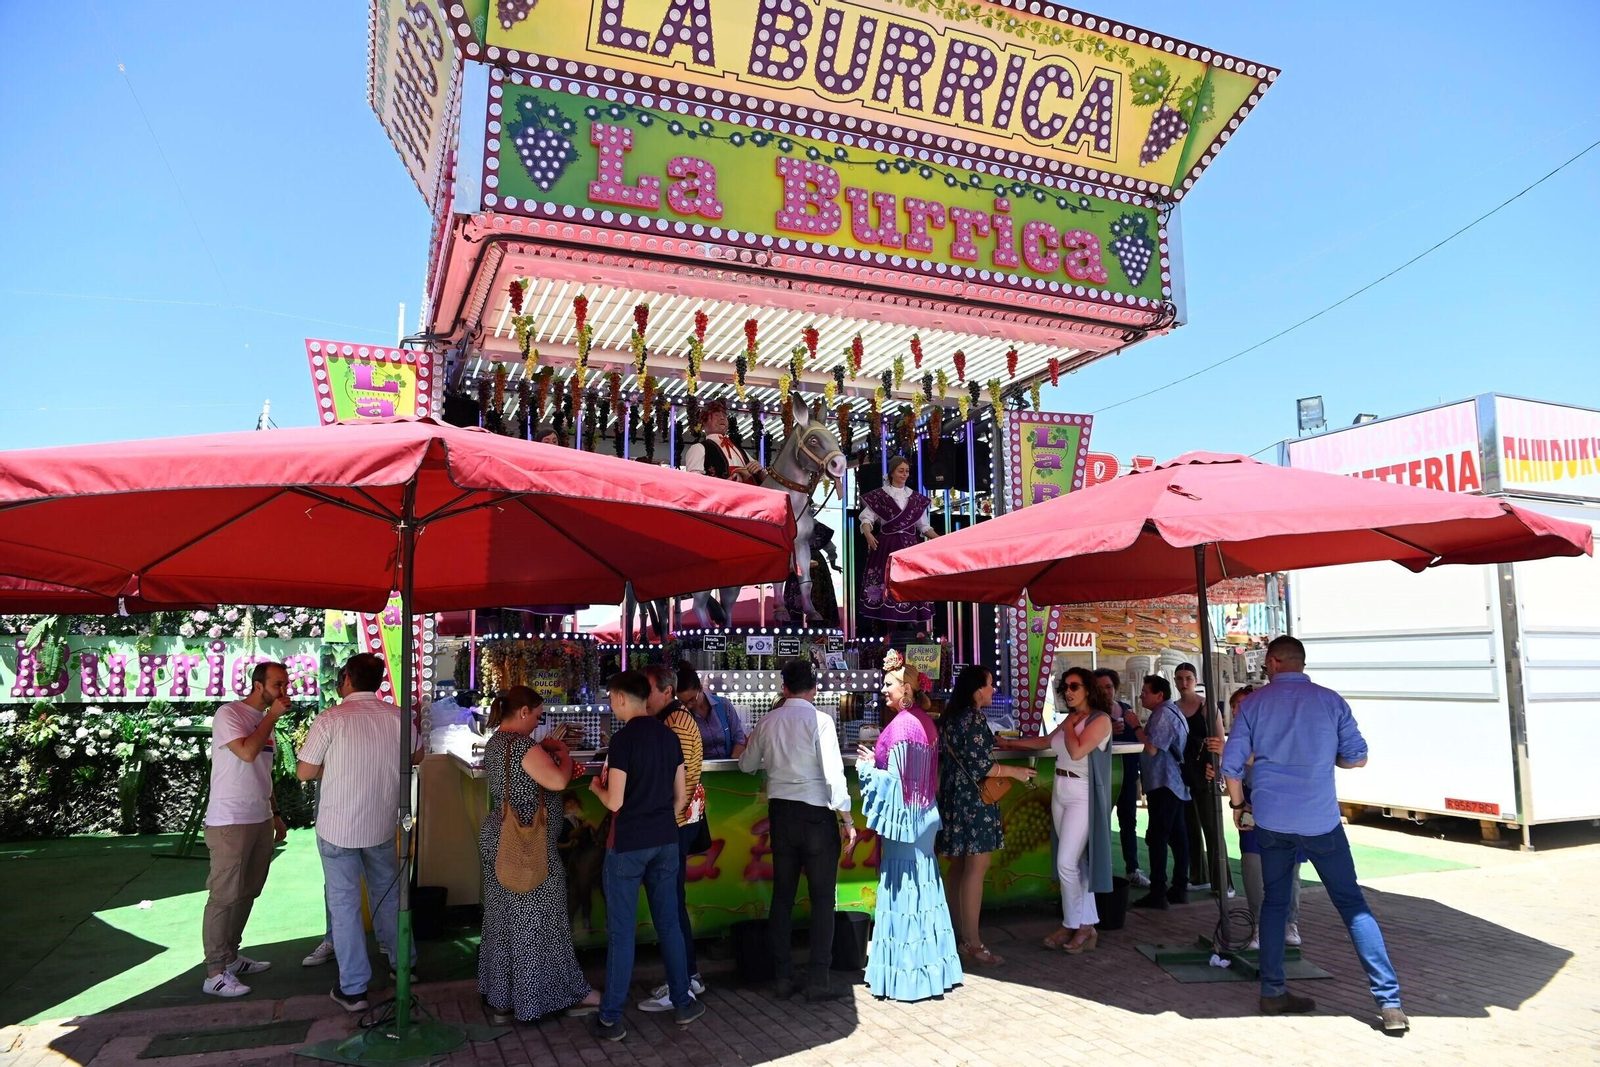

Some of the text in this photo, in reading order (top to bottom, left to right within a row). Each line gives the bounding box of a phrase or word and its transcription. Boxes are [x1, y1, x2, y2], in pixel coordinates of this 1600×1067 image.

[746, 0, 1115, 154] BURRICA
[588, 121, 1109, 285] La Burrica
[1344, 450, 1480, 492] TTERIA
[10, 638, 320, 697] Burrica
